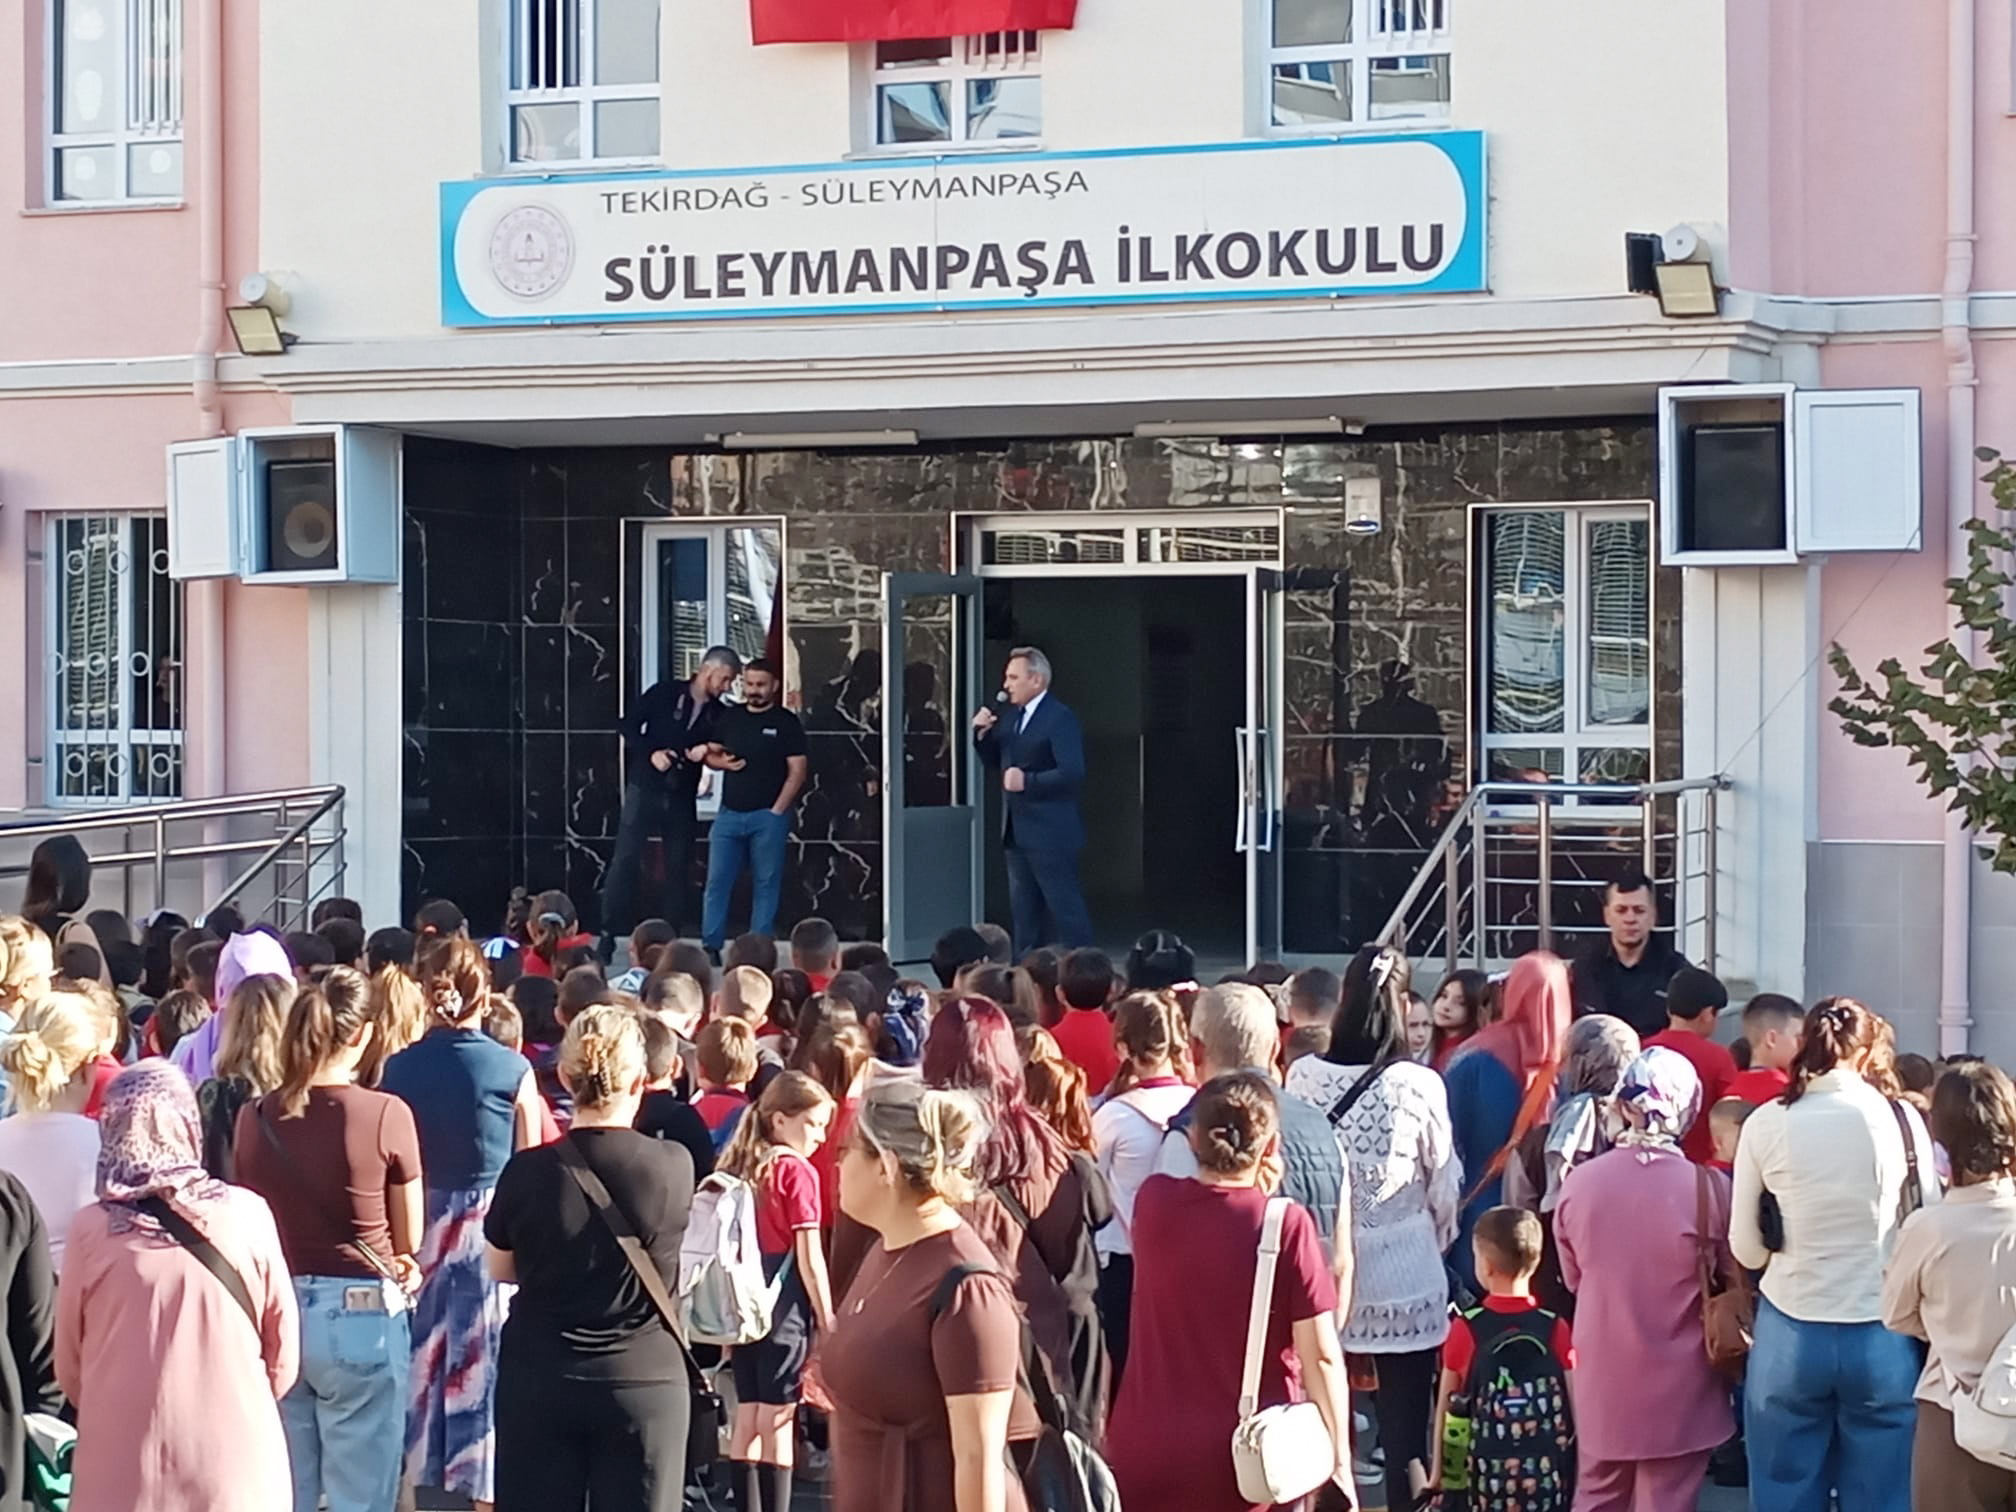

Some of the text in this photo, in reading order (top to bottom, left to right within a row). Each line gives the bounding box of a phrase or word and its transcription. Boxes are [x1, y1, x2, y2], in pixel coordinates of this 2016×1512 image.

[601, 182, 768, 213] TEKİRDAĞ
[801, 171, 1089, 206] SÜLEYMANPAŞA
[604, 239, 1095, 301] SÜLEYMANPAŞA
[1117, 223, 1444, 283] İLKOKULU
